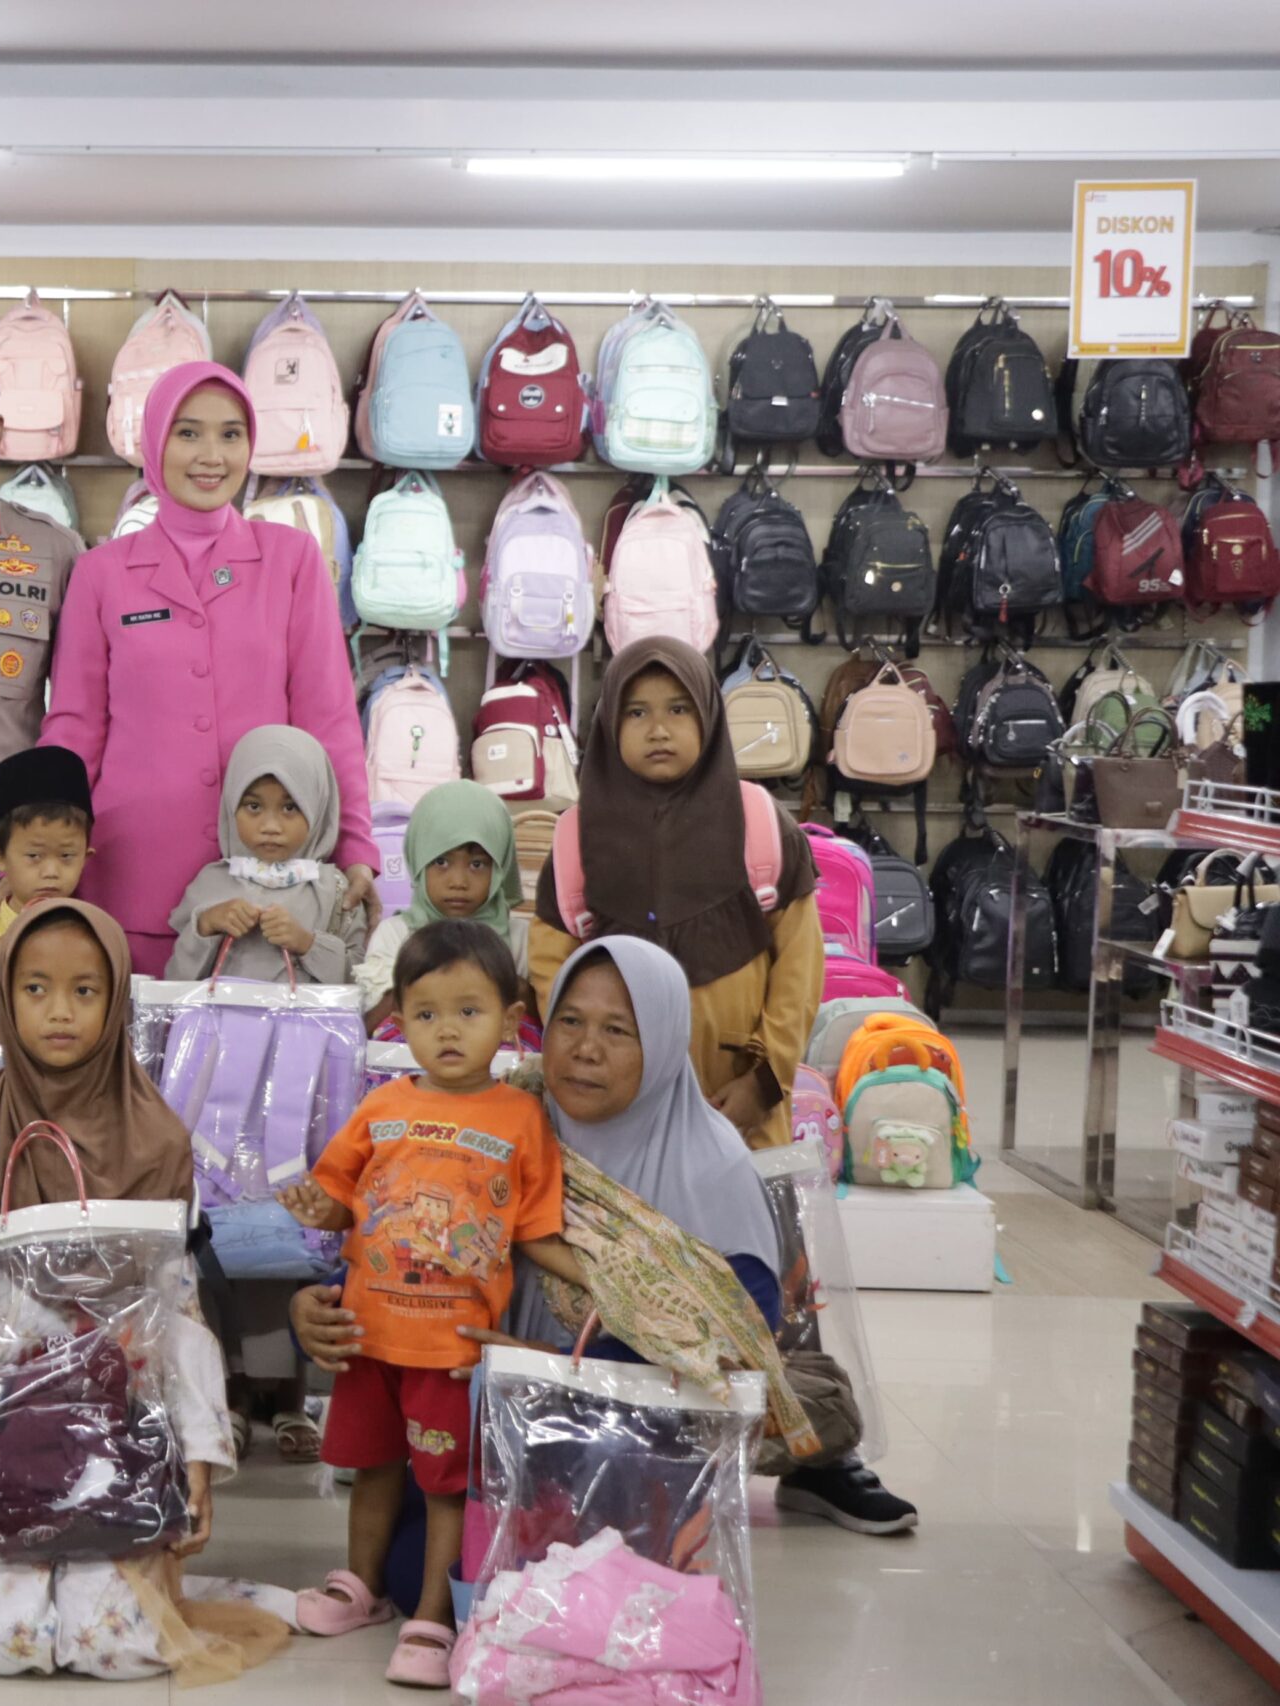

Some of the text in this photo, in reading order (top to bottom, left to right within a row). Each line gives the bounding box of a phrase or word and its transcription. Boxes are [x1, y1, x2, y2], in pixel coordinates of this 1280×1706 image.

[1096, 215, 1175, 234] DISKON
[1093, 248, 1172, 298] 10%
[370, 1121, 406, 1140] EGO
[408, 1121, 458, 1142] SUPER
[458, 1129, 514, 1161] HEROES
[386, 1294, 456, 1310] EXCLUSIVE
